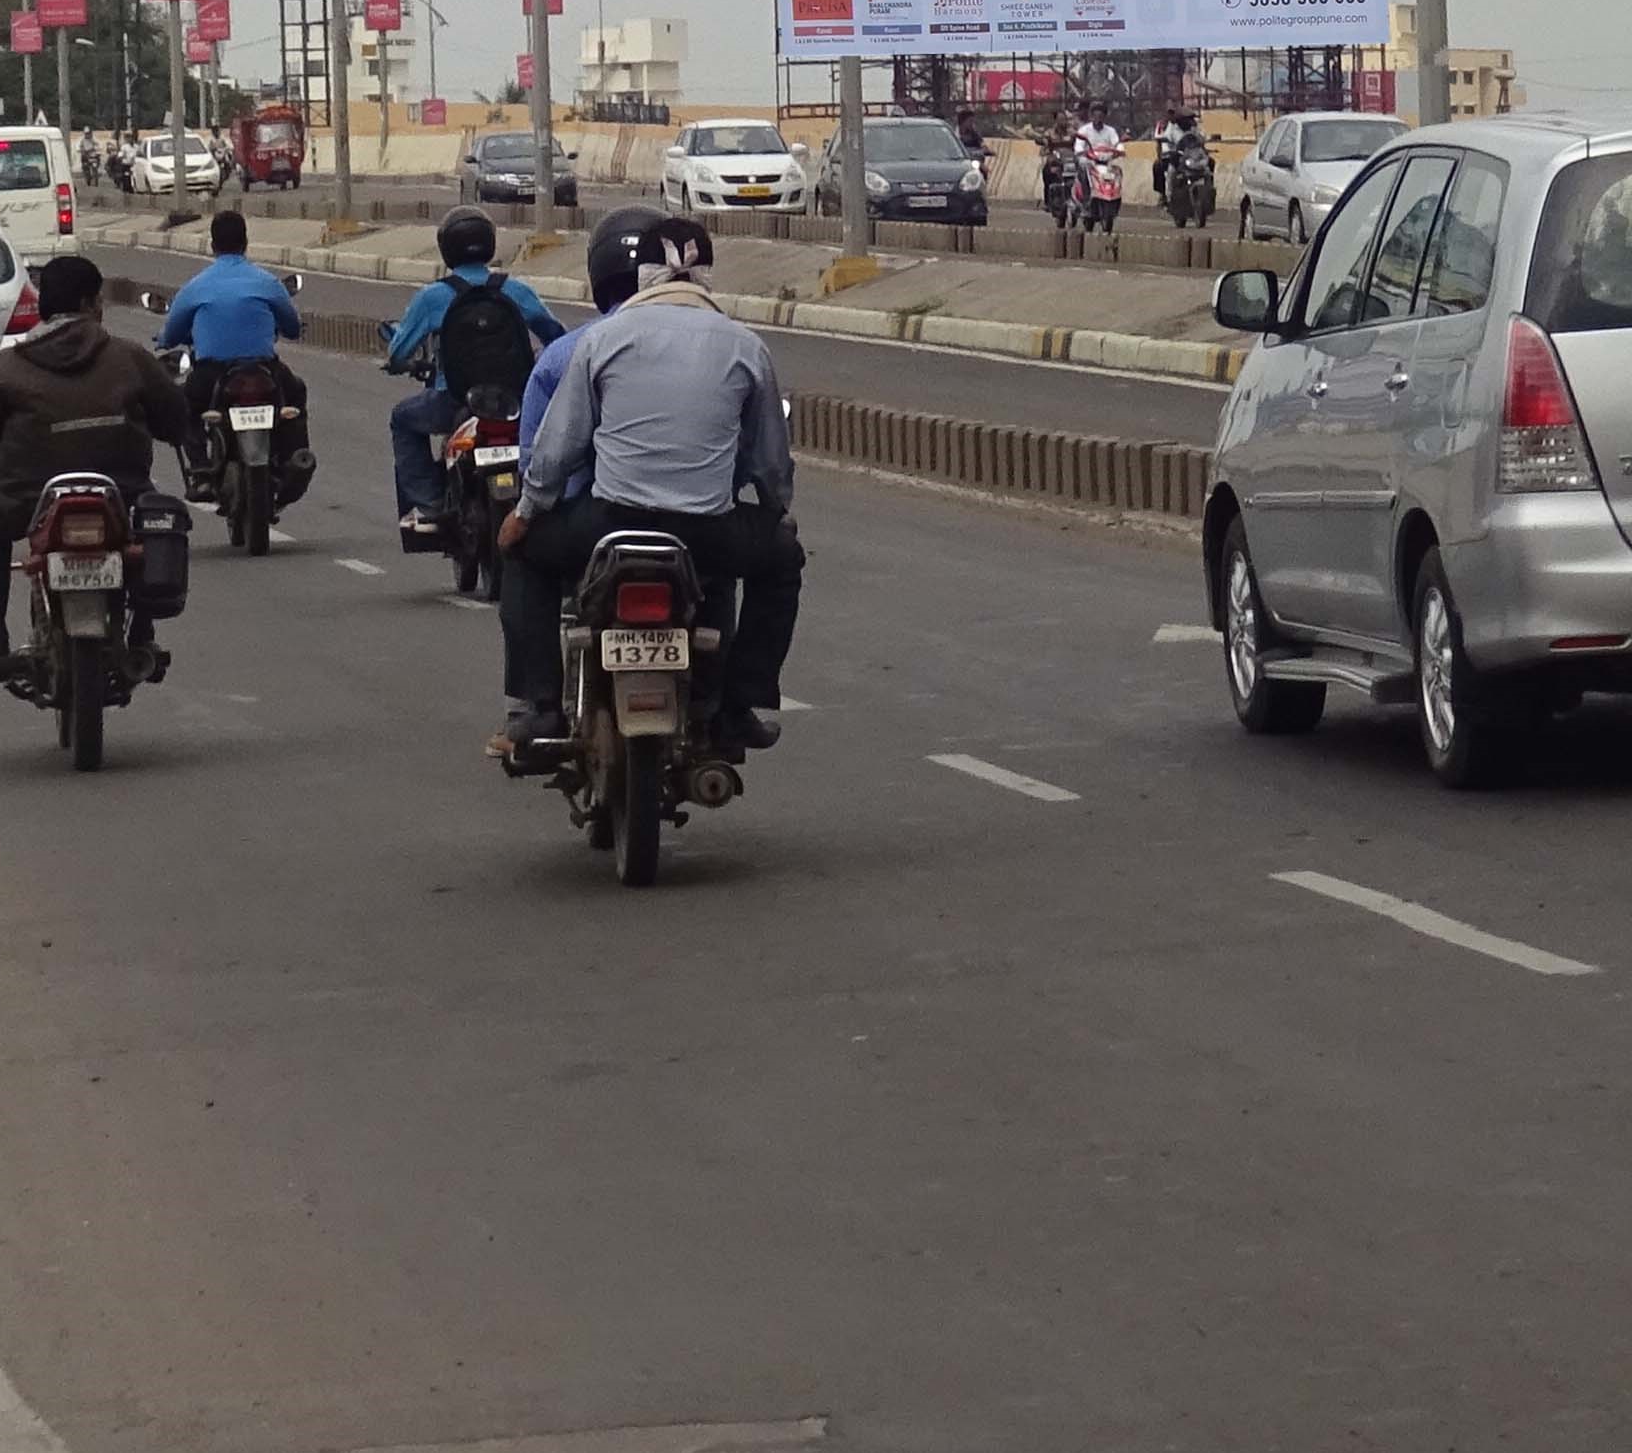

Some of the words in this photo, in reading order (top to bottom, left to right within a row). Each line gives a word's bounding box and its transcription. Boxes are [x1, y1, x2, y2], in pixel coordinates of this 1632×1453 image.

[934, 7, 984, 17] Harmony
[1012, 10, 1044, 18] TOWER
[1229, 14, 1367, 27] www.politegrouppune.com
[610, 646, 680, 663] 1378
